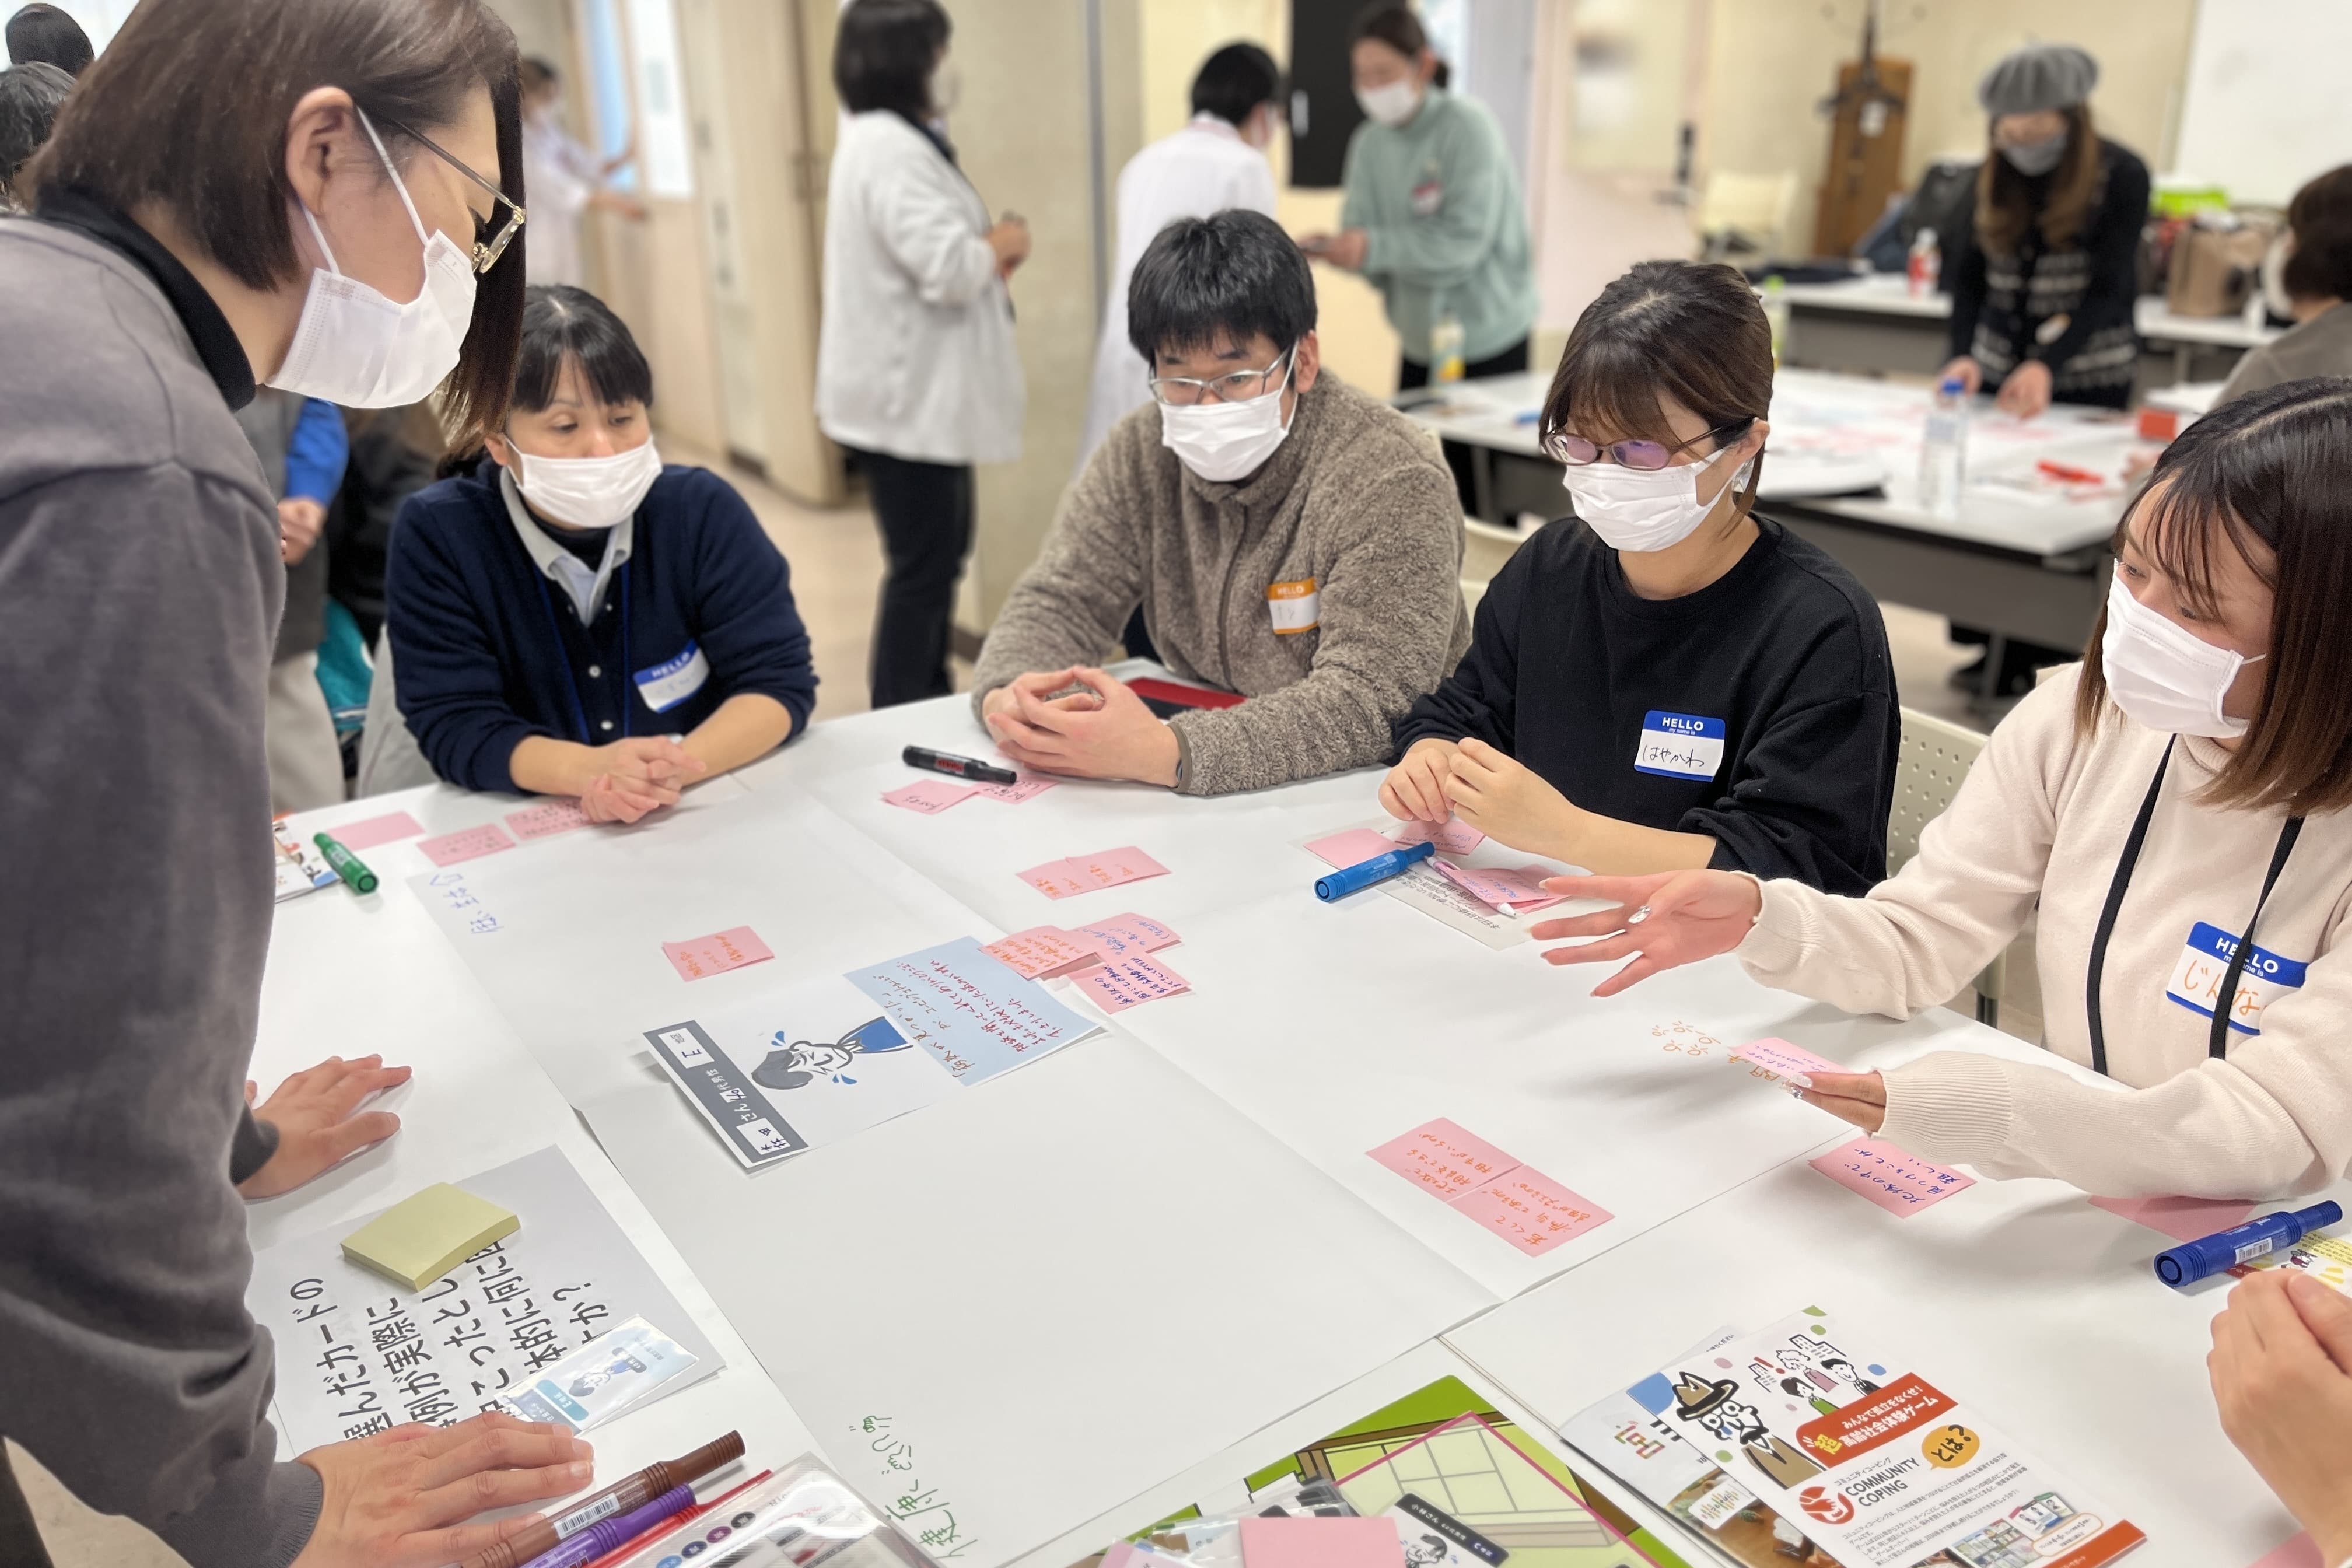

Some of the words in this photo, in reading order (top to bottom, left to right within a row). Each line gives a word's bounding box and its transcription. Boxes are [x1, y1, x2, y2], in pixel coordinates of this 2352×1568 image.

[1662, 717, 1704, 731] HELLO
[1643, 745, 1704, 768] はやかわ
[2216, 937, 2278, 974] HELO
[289, 1278, 391, 1440] 選んだカードの
[422, 1278, 517, 1423] こったとし
[1814, 1433, 1842, 1455] 超
[1838, 1395, 1940, 1447] 高齢社会体験ゲーム
[1840, 1385, 1924, 1430] みんなで孤立をなくせ！
[1931, 1424, 1967, 1462] とは？
[1844, 1457, 1919, 1497] COMMUNITY
[1857, 1479, 1908, 1507] COPING
[885, 1479, 977, 1568] 健康
